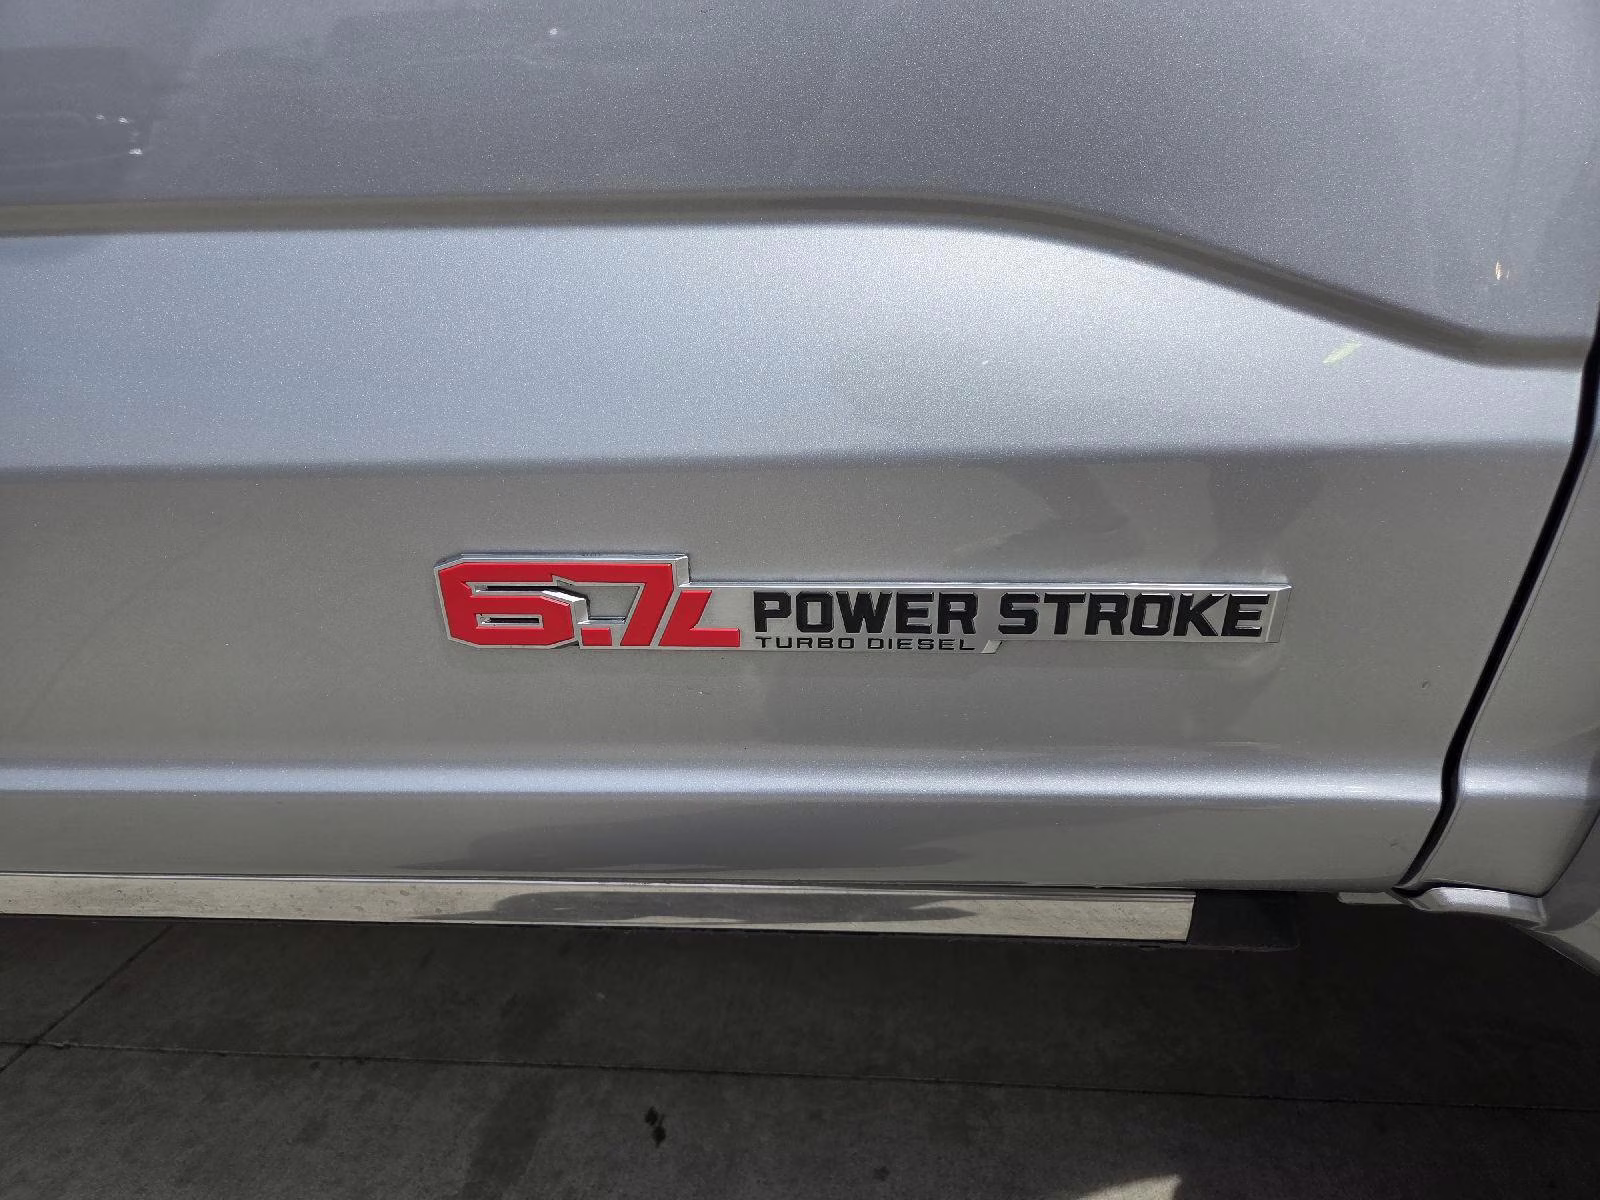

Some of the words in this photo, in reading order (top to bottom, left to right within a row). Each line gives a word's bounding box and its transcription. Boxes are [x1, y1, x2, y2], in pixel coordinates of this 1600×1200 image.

[437, 561, 741, 648] 6.7L
[753, 591, 979, 635] POWER
[998, 592, 1270, 637] STROKE
[755, 635, 855, 649] TURBO
[867, 637, 976, 650] DIESEL
